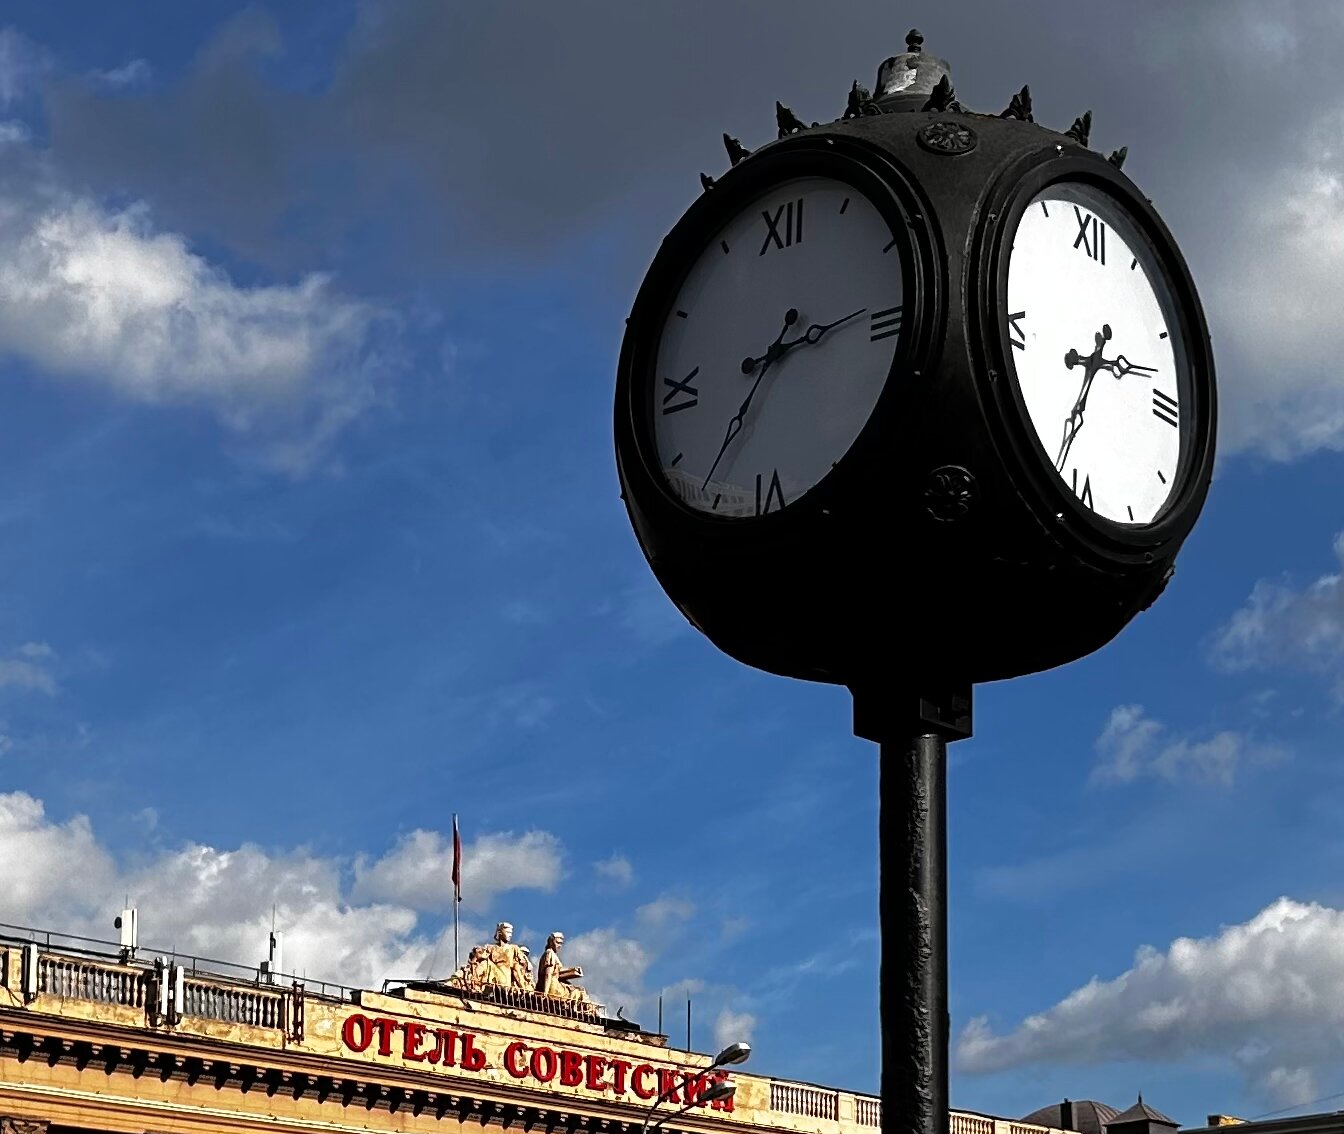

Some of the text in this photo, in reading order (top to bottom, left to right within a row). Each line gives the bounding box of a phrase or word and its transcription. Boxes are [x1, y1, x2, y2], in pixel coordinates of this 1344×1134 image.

[759, 197, 804, 257] XII
[1073, 205, 1106, 266] XII
[870, 304, 903, 342] III
[663, 366, 699, 415] IX
[1152, 388, 1178, 428] III
[342, 1014, 487, 1071] ОТЕЛЬ
